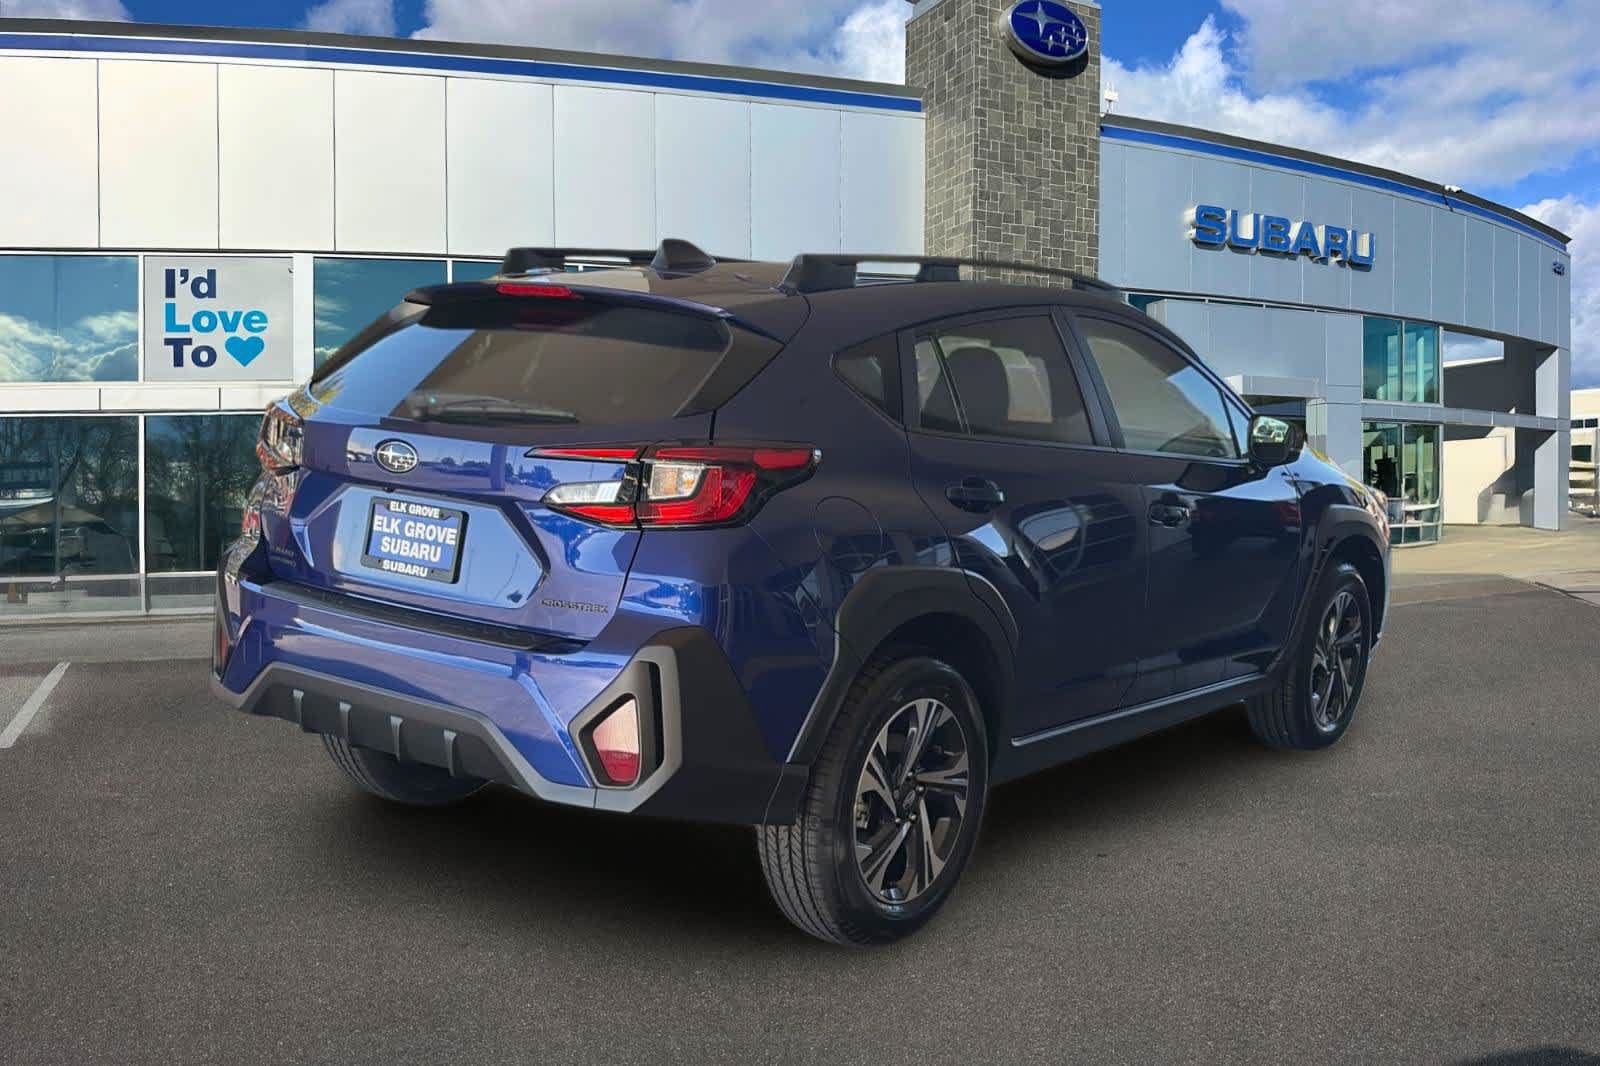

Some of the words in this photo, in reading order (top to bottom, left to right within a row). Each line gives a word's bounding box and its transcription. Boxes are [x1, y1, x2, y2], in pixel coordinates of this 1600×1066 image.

[1193, 205, 1376, 268] SUBARU
[165, 269, 216, 299] I’d
[165, 303, 268, 333] Love
[164, 338, 217, 368] To
[389, 500, 407, 513] ELK
[408, 503, 441, 519] GROVE
[373, 514, 402, 535] ELK
[404, 520, 458, 545] GROVE
[380, 535, 441, 563] SUBARU
[382, 559, 429, 577] SUBARU
